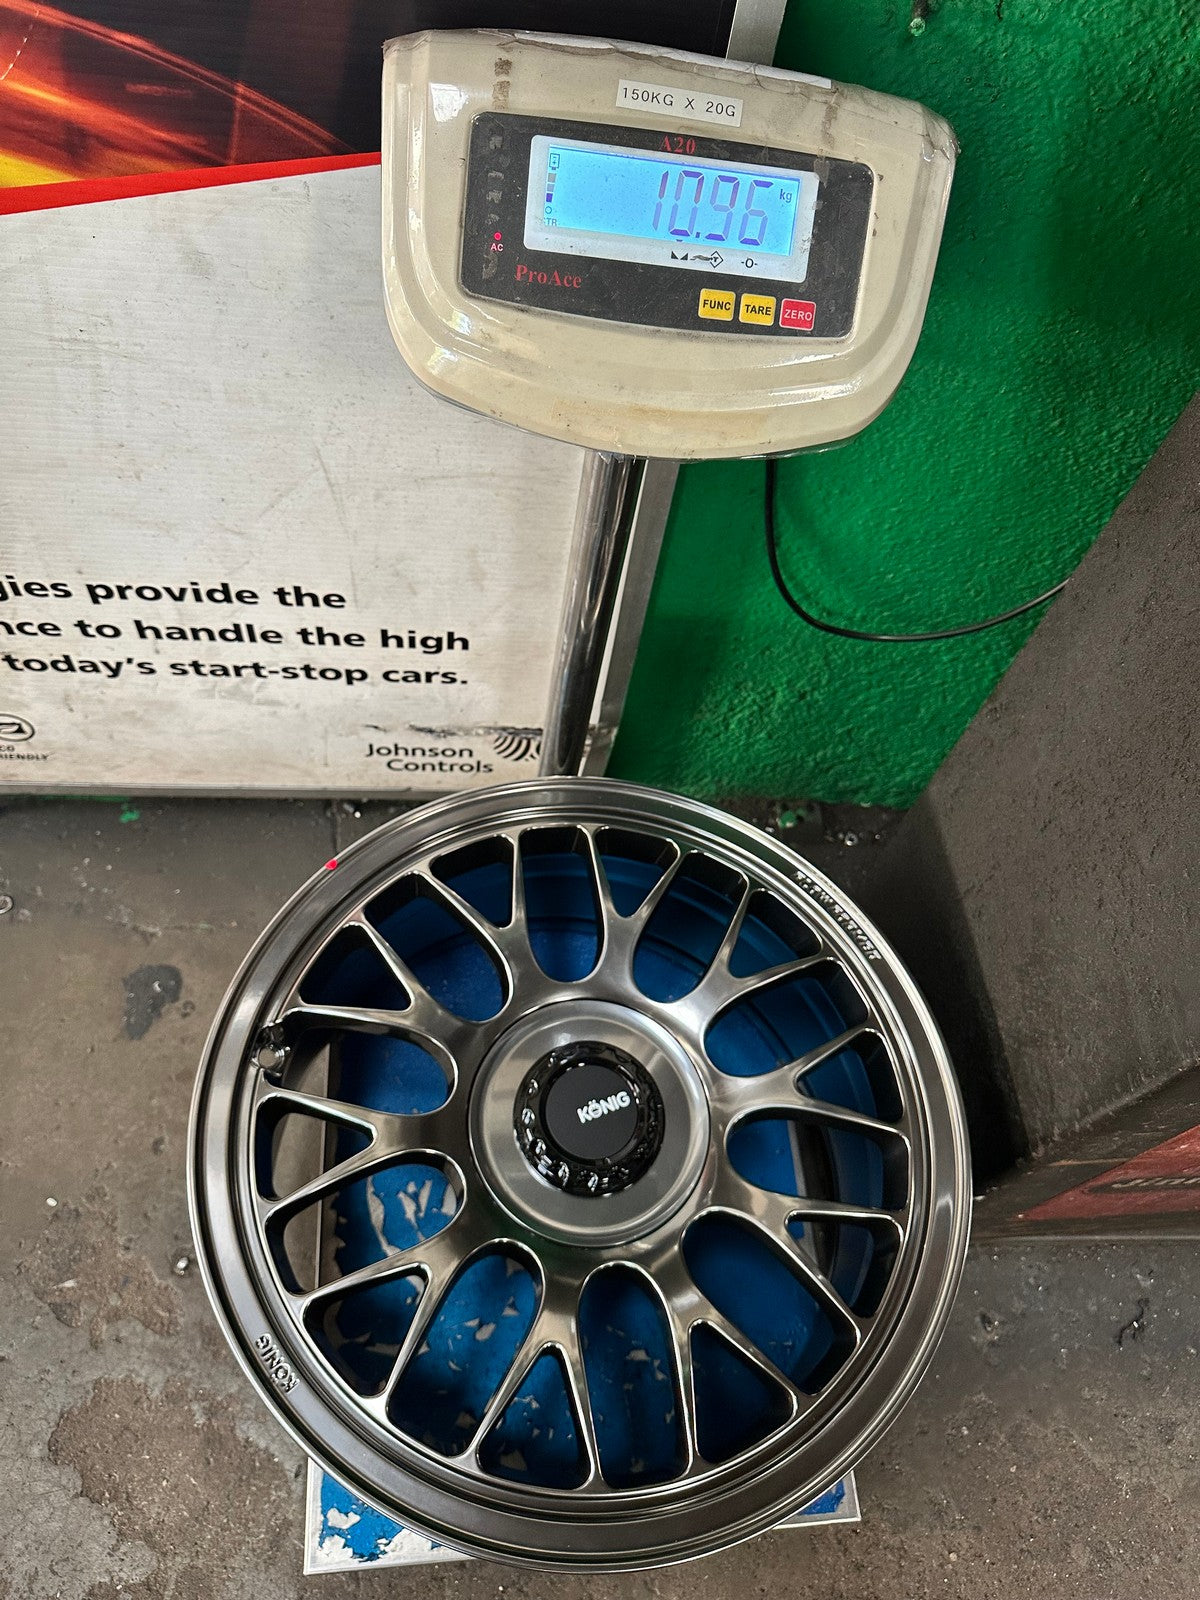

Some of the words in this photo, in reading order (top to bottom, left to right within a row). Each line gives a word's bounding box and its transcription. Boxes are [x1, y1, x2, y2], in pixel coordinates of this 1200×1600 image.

[622, 86, 674, 107] 150KG
[684, 97, 695, 111] X
[705, 101, 736, 117] 20G
[660, 134, 697, 155] A20
[652, 170, 774, 246] 10.96
[779, 188, 793, 203] kg
[490, 242, 504, 252] AC
[514, 264, 582, 289] ProAce
[702, 299, 732, 312] FUNC
[744, 304, 772, 316] TARE
[783, 310, 813, 321] ZERO
[85, 581, 260, 605] provide
[273, 585, 347, 609] the
[73, 619, 122, 639] to
[133, 619, 283, 644] handle
[296, 626, 366, 647] the
[380, 629, 470, 655] high
[1, 654, 157, 678] today's
[169, 660, 369, 686] start-stop
[382, 669, 469, 685] cars.
[365, 743, 474, 758] Johnson
[386, 758, 494, 774] Controls
[576, 1090, 631, 1124] KÖNIG
[255, 1333, 300, 1394] KÖNIG
